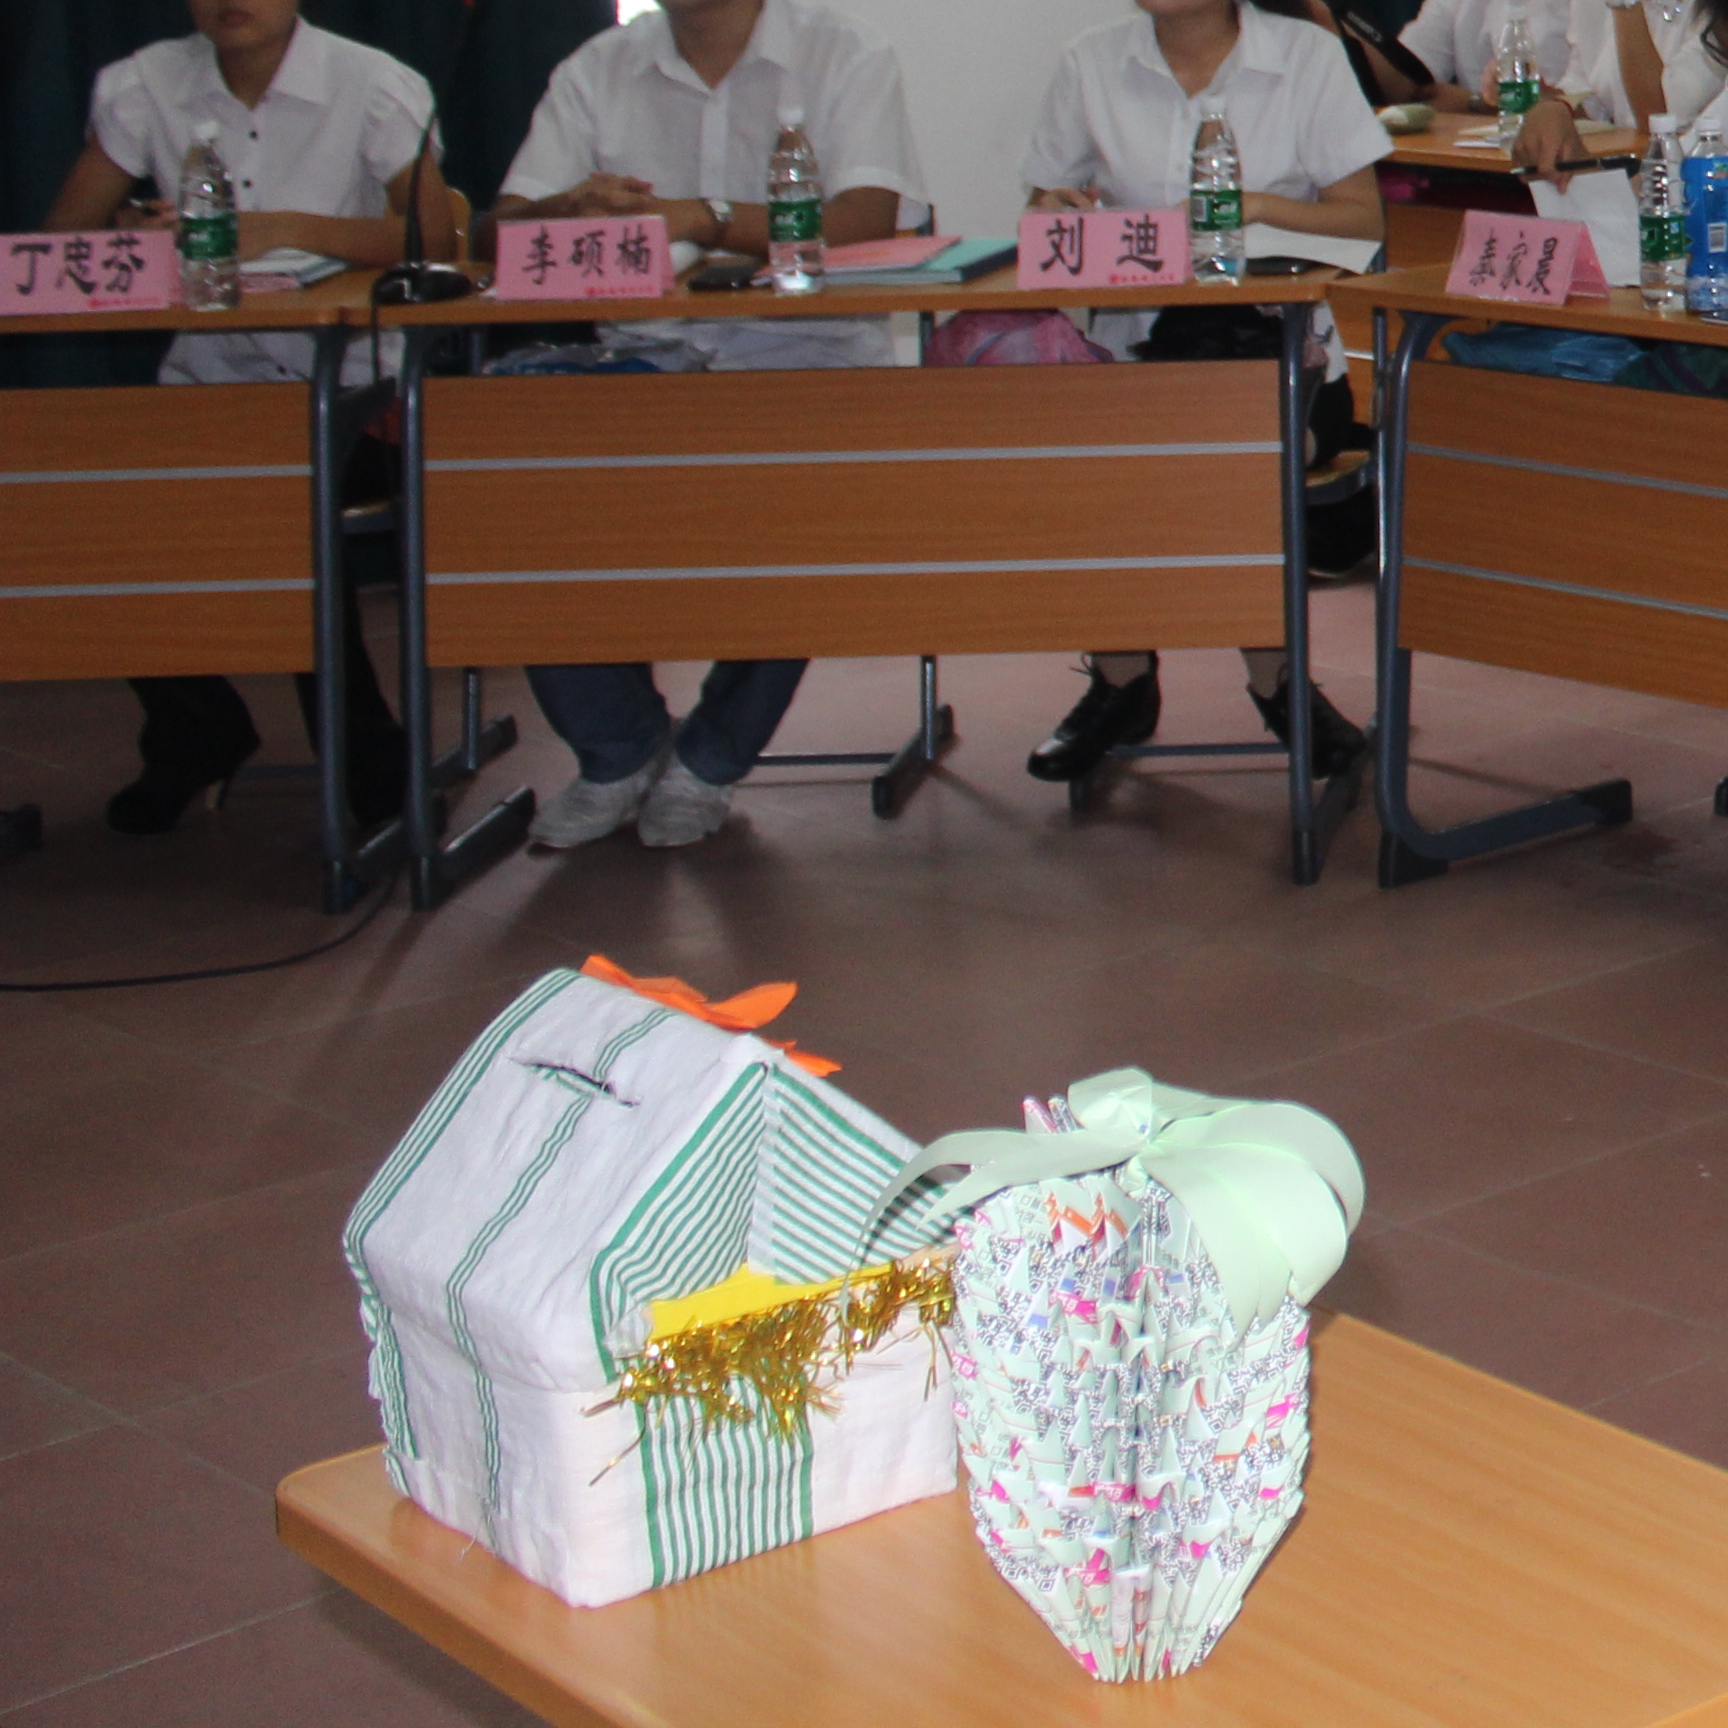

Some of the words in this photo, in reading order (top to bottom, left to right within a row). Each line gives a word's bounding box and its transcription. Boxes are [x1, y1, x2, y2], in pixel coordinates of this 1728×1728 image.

[12, 233, 145, 296] 丁忠芬
[521, 223, 653, 285] 李硕楠
[1040, 214, 1164, 276] 刘迪
